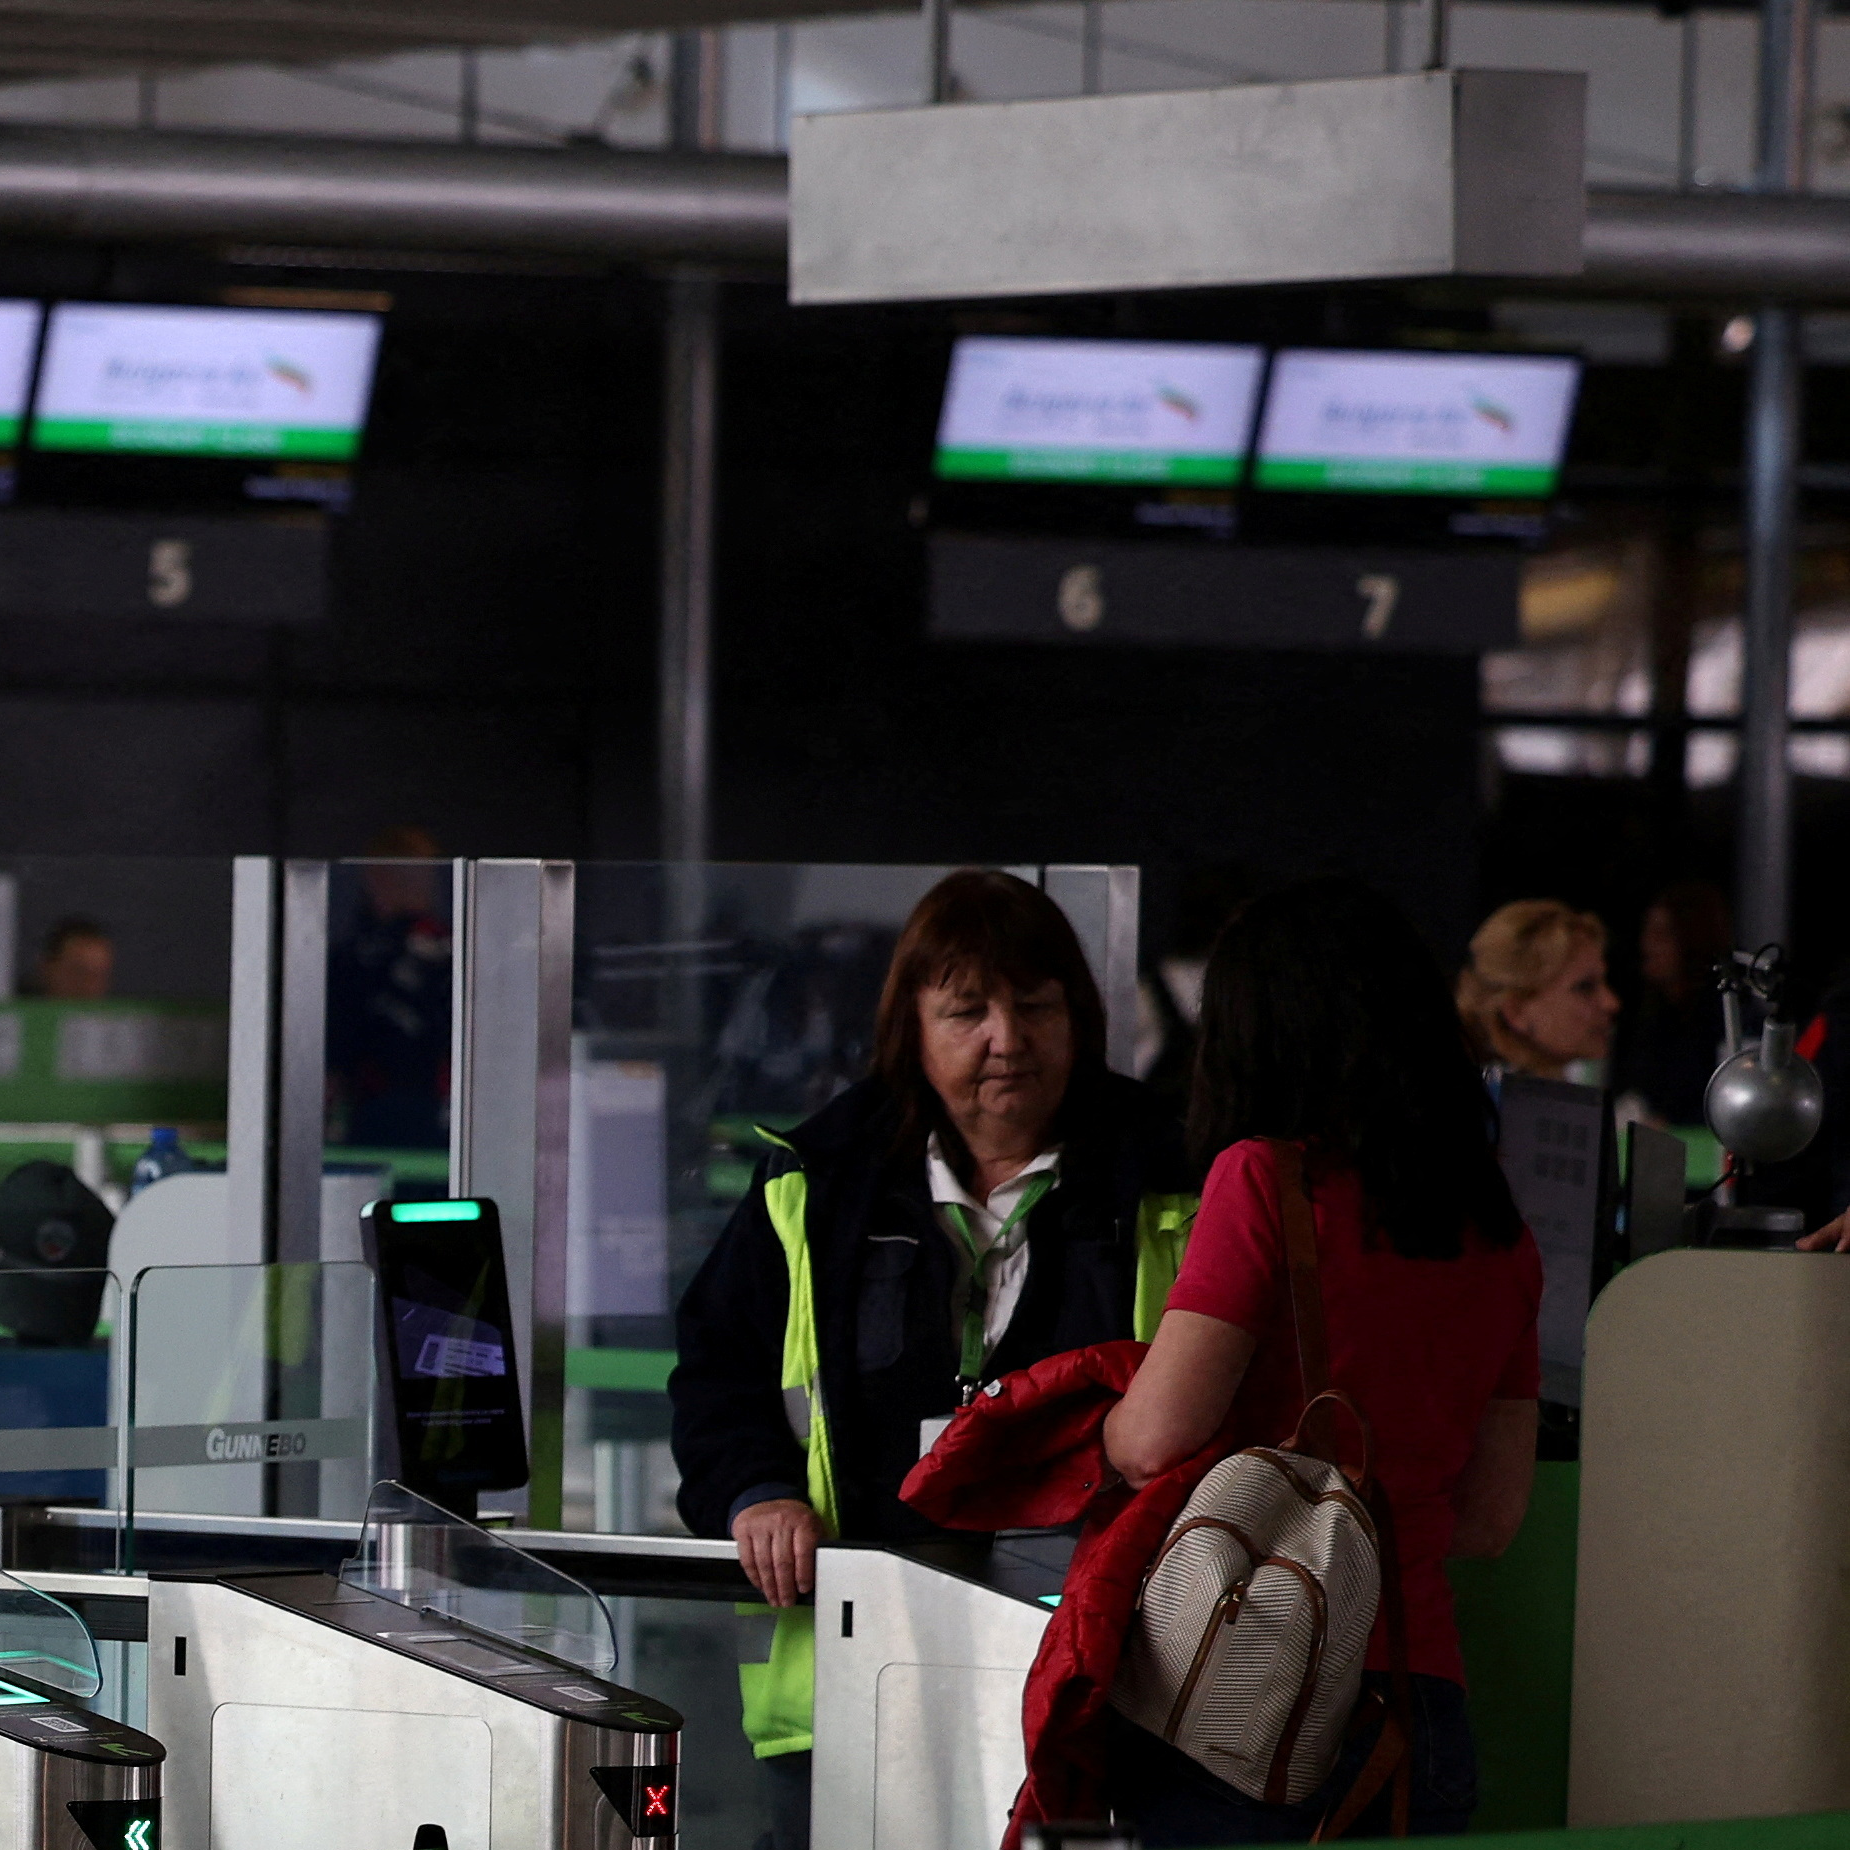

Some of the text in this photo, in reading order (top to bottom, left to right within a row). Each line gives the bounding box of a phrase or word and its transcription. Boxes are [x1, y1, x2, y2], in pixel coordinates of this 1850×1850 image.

[147, 538, 192, 609] 5
[1057, 564, 1102, 632] 6
[1356, 573, 1398, 639] 7
[206, 1427, 306, 1460] GUNNEBO
